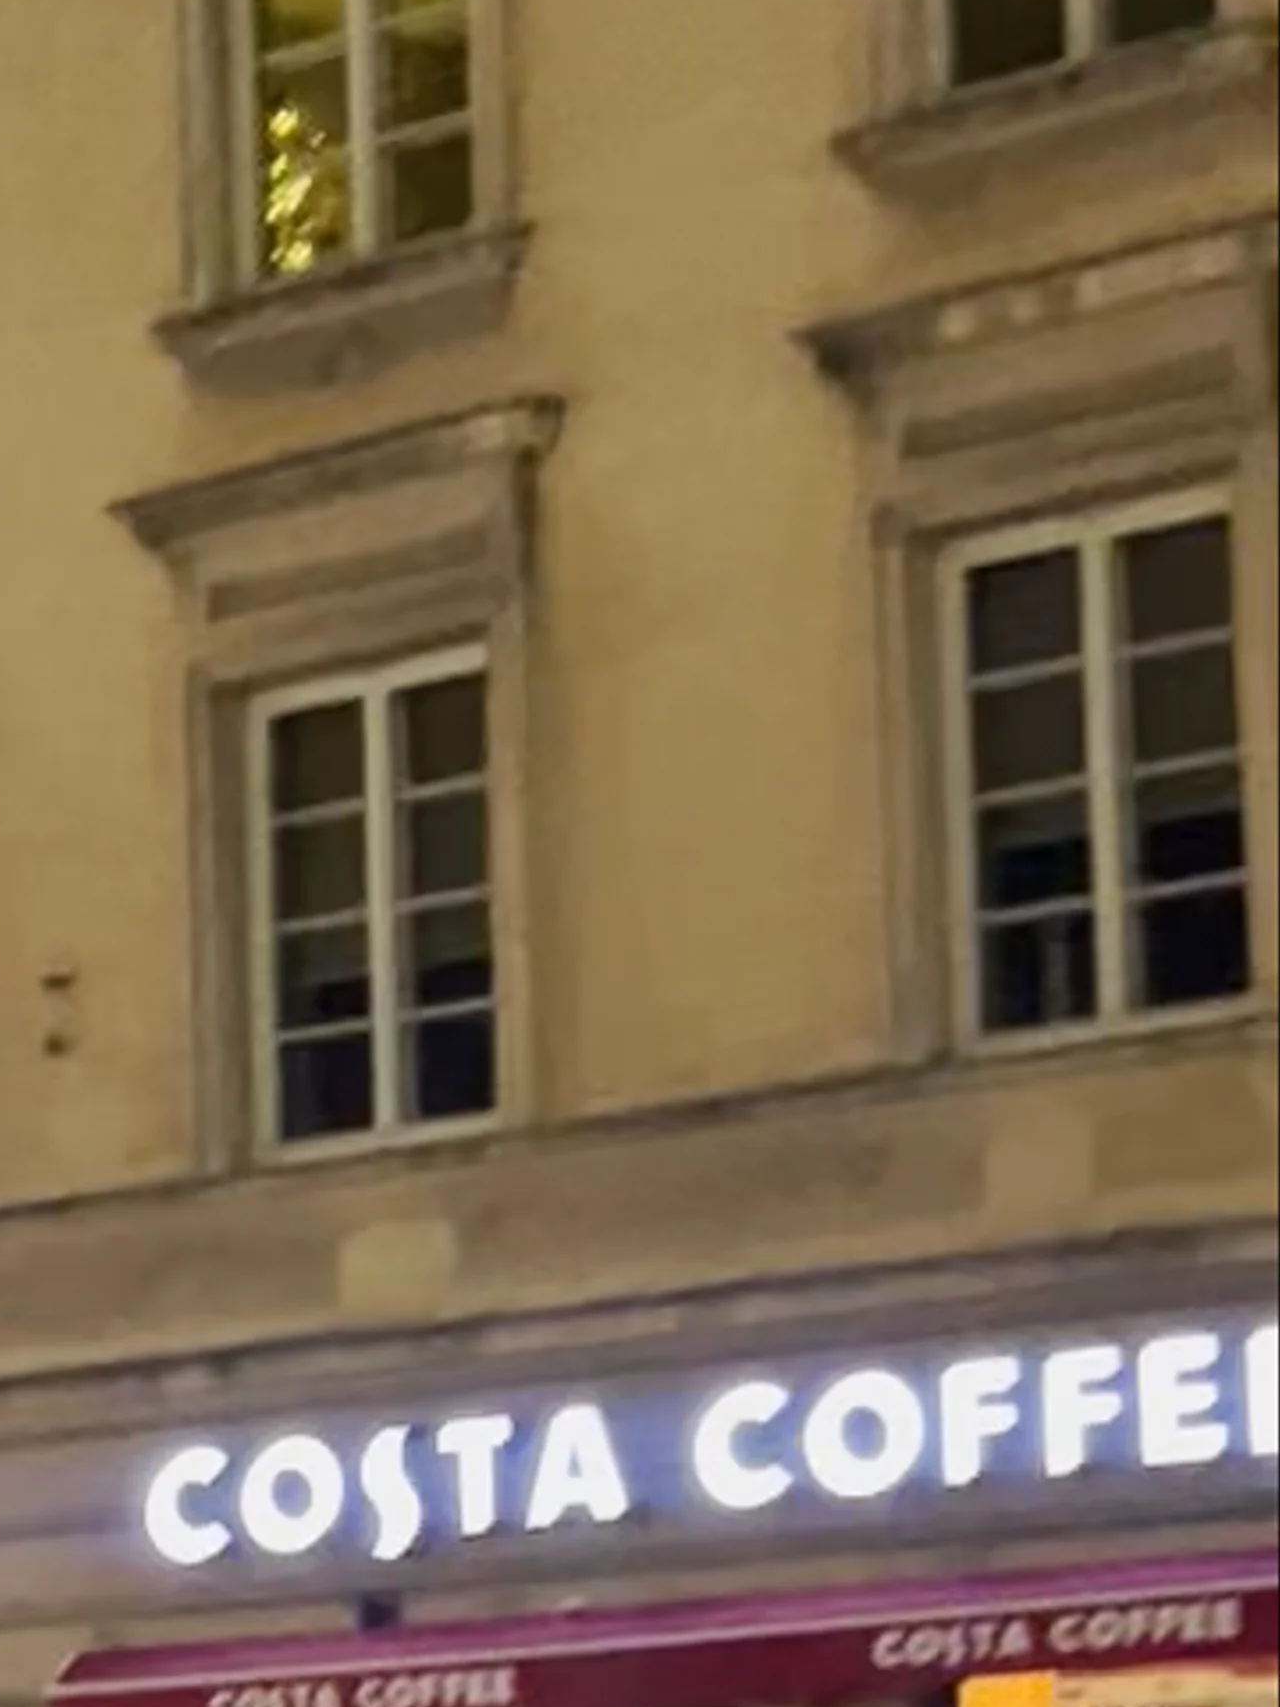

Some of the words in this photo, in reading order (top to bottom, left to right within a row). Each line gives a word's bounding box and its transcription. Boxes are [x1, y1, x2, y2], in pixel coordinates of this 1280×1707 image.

[145, 1404, 630, 1565] COSTA
[871, 1619, 1032, 1669] COSTA
[1050, 1598, 1242, 1652] COFFEE
